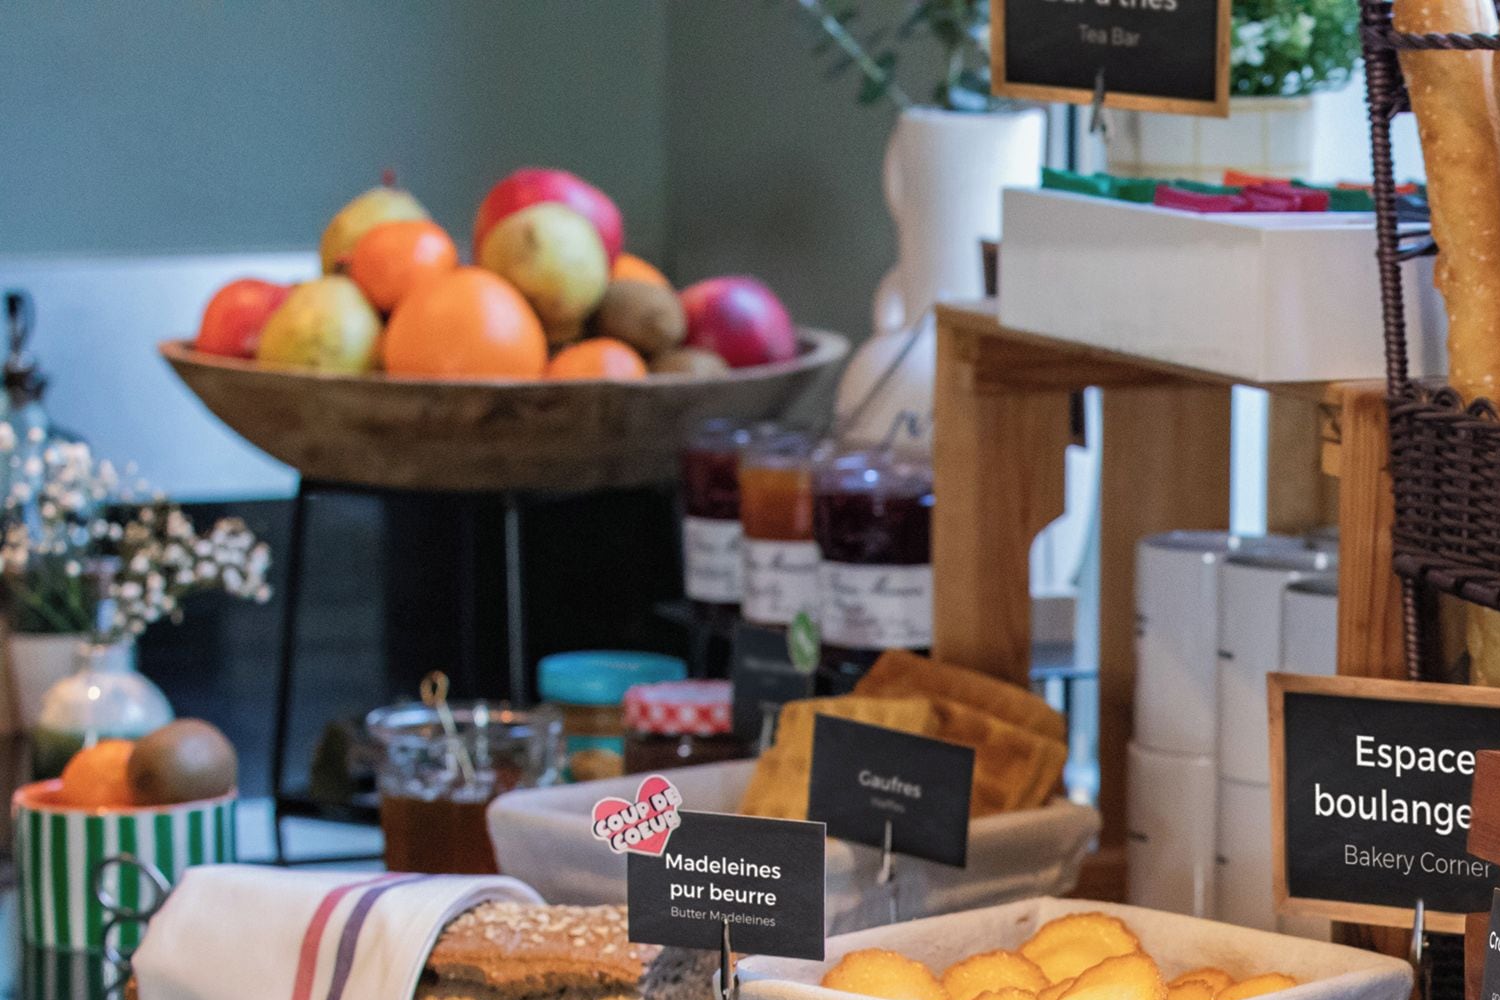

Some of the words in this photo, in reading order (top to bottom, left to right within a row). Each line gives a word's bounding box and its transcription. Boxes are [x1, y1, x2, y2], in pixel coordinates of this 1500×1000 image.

[1079, 22, 1106, 44] Tea
[1111, 26, 1140, 47] Bar
[1356, 734, 1476, 778] Espace
[858, 769, 922, 799] Gaufres
[594, 801, 649, 839] COUP
[611, 810, 680, 851] COEUR
[665, 852, 782, 880] Madeleines
[1344, 844, 1415, 875] Bakery
[1420, 851, 1492, 879] Corner
[670, 882, 704, 901] pur
[709, 883, 777, 907] beurre
[671, 905, 707, 921] Butter
[709, 911, 777, 928] Madeleines
